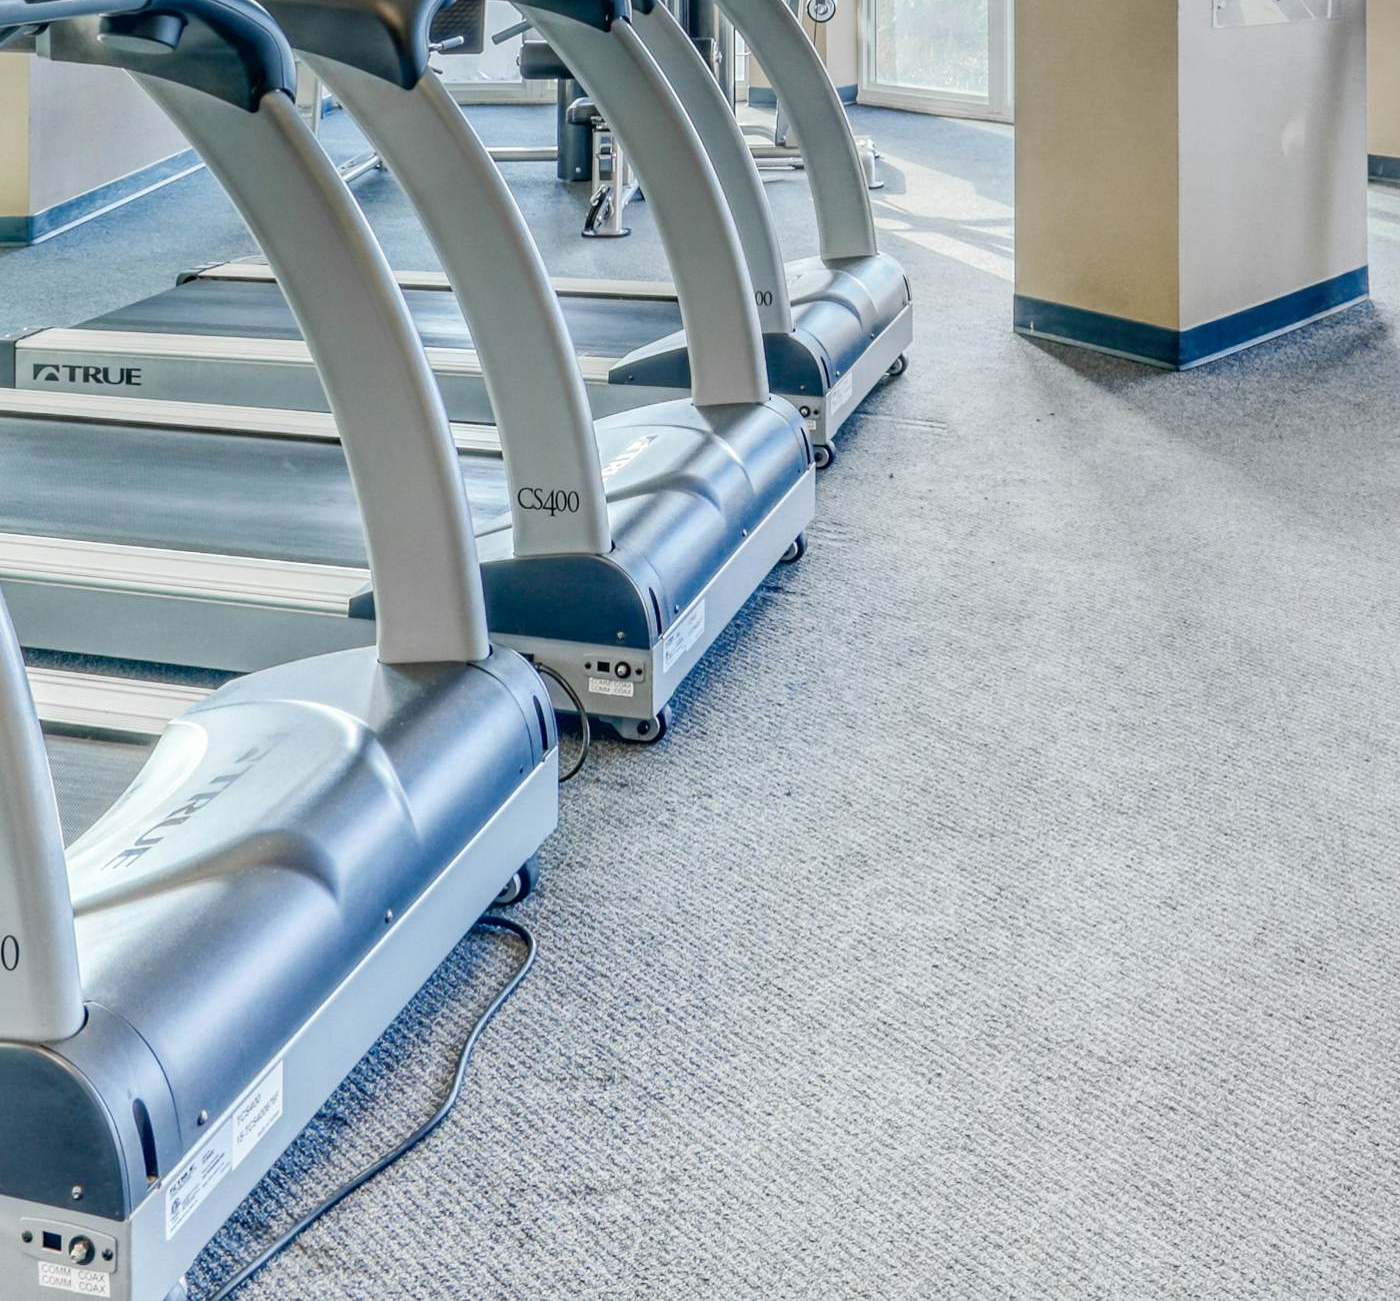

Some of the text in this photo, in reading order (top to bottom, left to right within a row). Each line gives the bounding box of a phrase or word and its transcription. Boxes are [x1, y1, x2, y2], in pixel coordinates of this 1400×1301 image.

[62, 364, 142, 386] TRUE
[517, 487, 580, 517] CS400
[100, 764, 253, 870] TRUE
[41, 1263, 105, 1282] COMM COAX
[41, 1274, 105, 1293] COMM COAX
